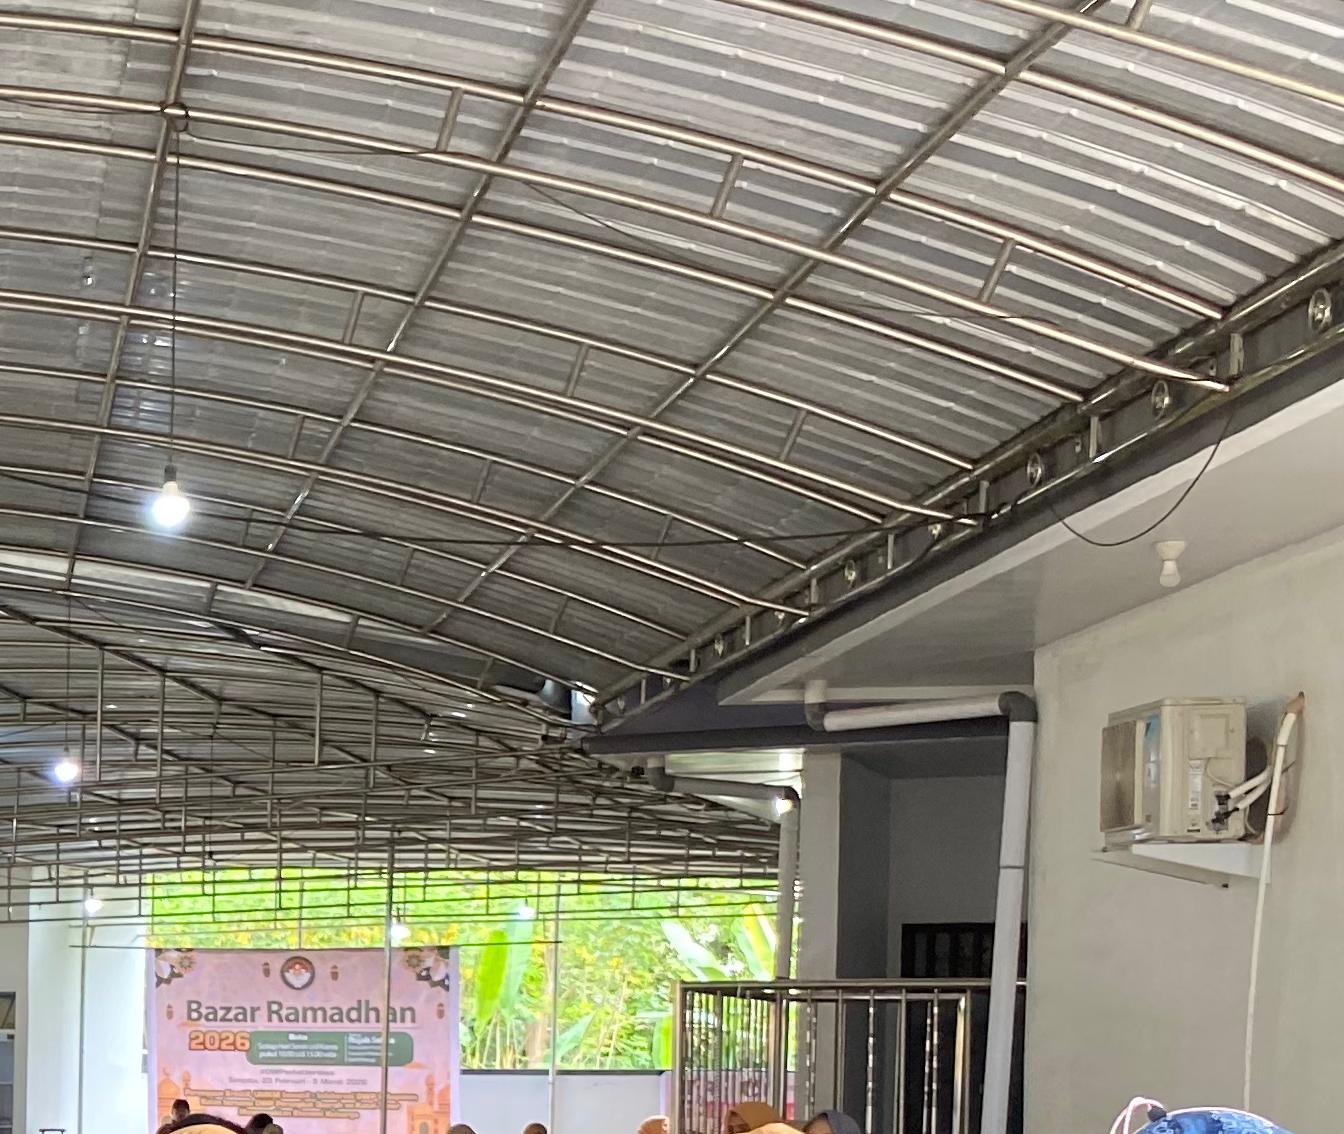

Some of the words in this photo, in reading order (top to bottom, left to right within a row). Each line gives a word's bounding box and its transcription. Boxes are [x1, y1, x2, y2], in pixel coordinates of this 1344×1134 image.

[186, 1000, 260, 1023] Bazar
[267, 999, 416, 1023] Ramadhan
[189, 1029, 250, 1051] 2026
